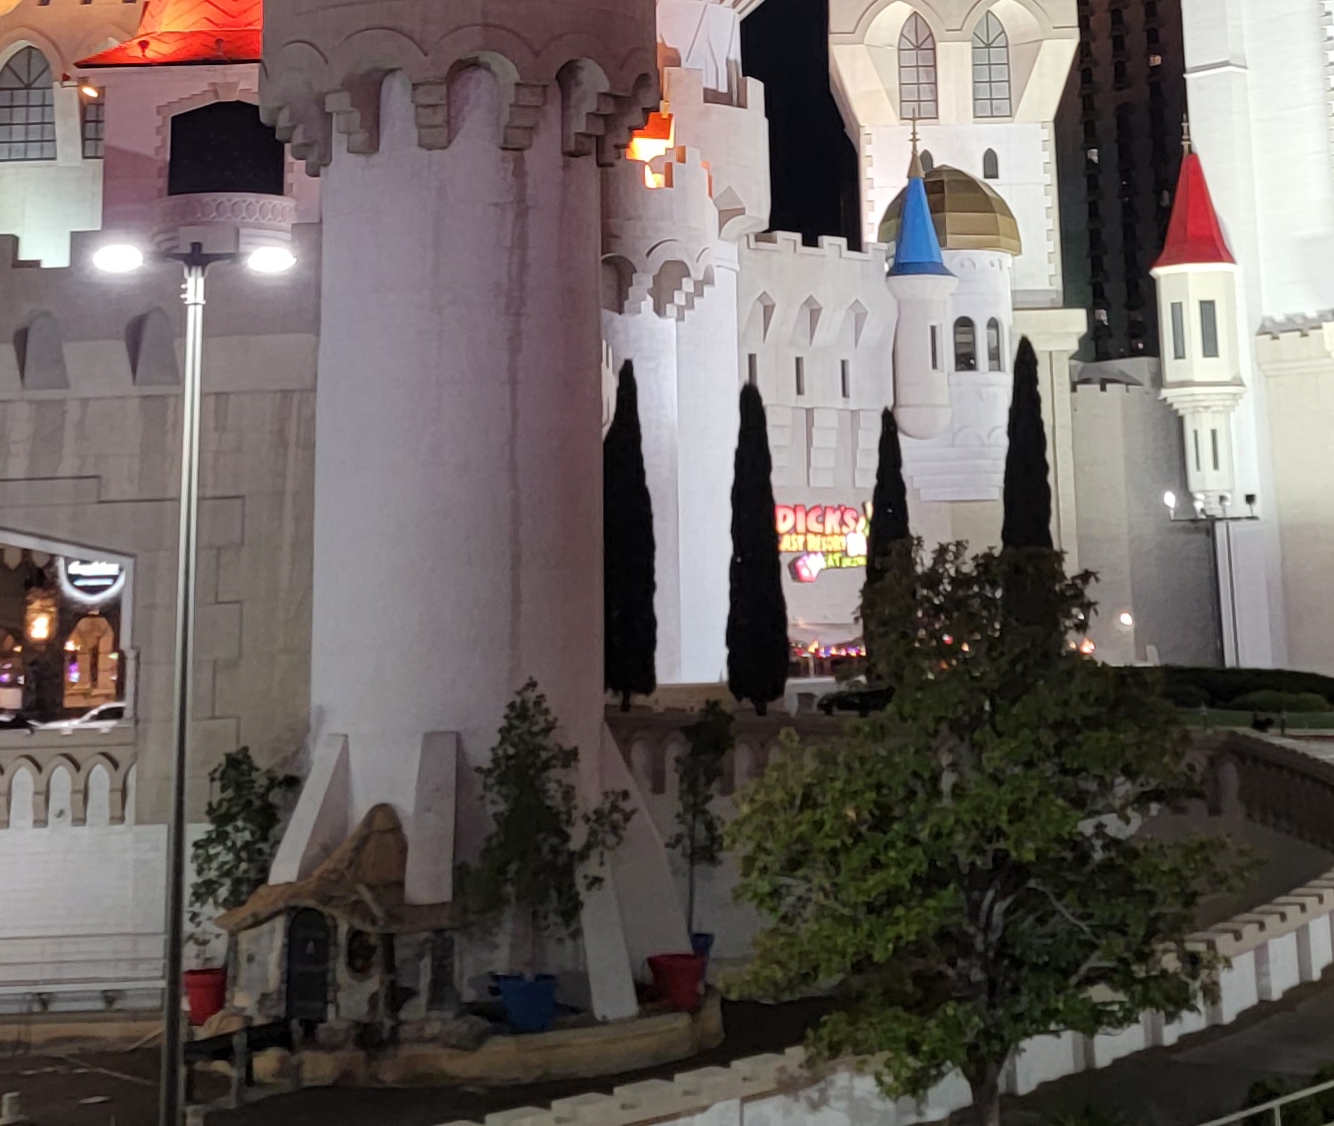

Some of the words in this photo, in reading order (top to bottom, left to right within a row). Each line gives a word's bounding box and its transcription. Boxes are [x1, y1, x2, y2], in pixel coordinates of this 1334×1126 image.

[775, 504, 858, 535] DICK'S
[779, 534, 805, 552] AST
[806, 534, 847, 552] RESORT
